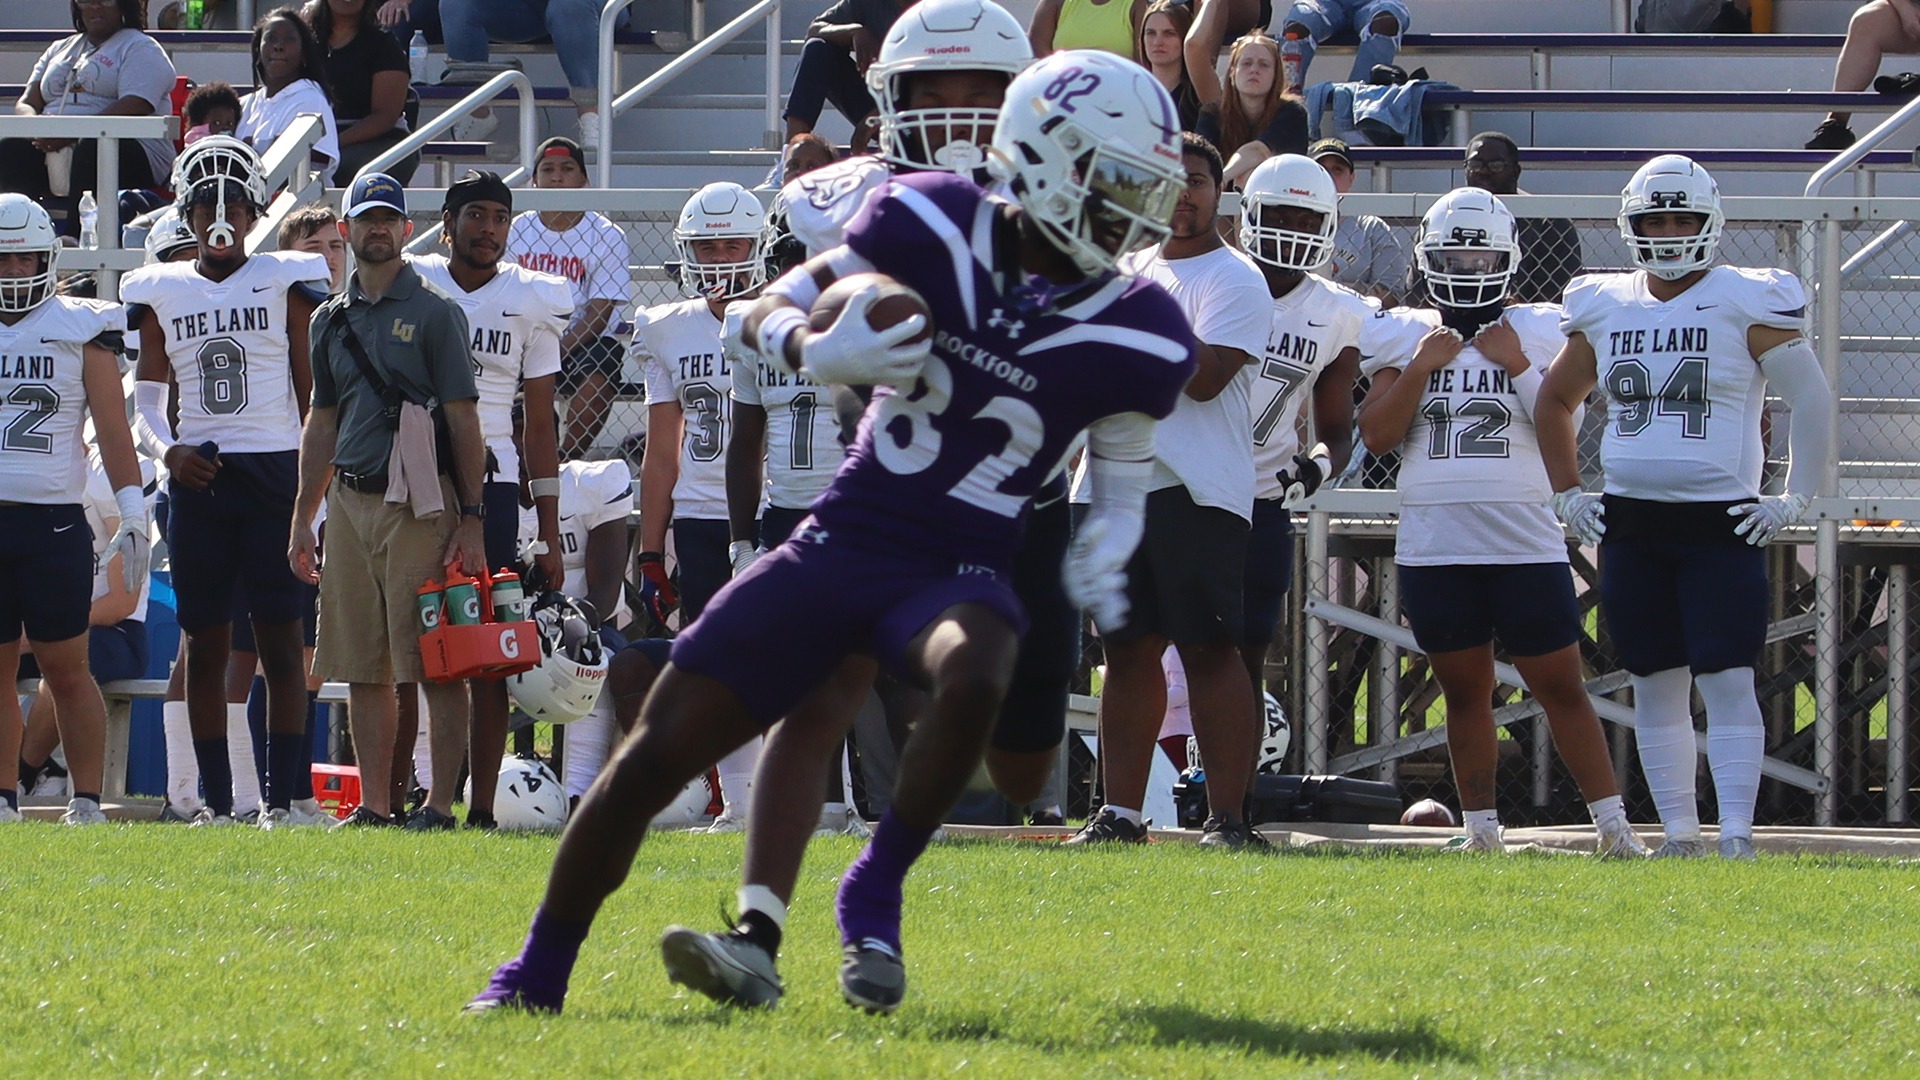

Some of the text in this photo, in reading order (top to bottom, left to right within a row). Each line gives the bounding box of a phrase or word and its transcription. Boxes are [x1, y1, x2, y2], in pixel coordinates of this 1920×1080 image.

[1044, 66, 1101, 114] 82
[172, 306, 270, 341] THE LAND
[392, 318, 416, 342] LU
[471, 327, 512, 355] AND
[1610, 327, 1708, 357] THE LAND
[0, 354, 54, 380] LAND
[196, 336, 248, 416] 8
[679, 353, 714, 381] THE
[935, 329, 1039, 393] ROCKFORD
[1428, 369, 1454, 393] HE
[683, 381, 731, 462] 3
[1253, 356, 1312, 447] 7
[1604, 356, 1711, 440] 94
[790, 392, 817, 470] 1
[872, 350, 1046, 519] 82
[1422, 397, 1512, 460] 12
[500, 628, 520, 659] G
